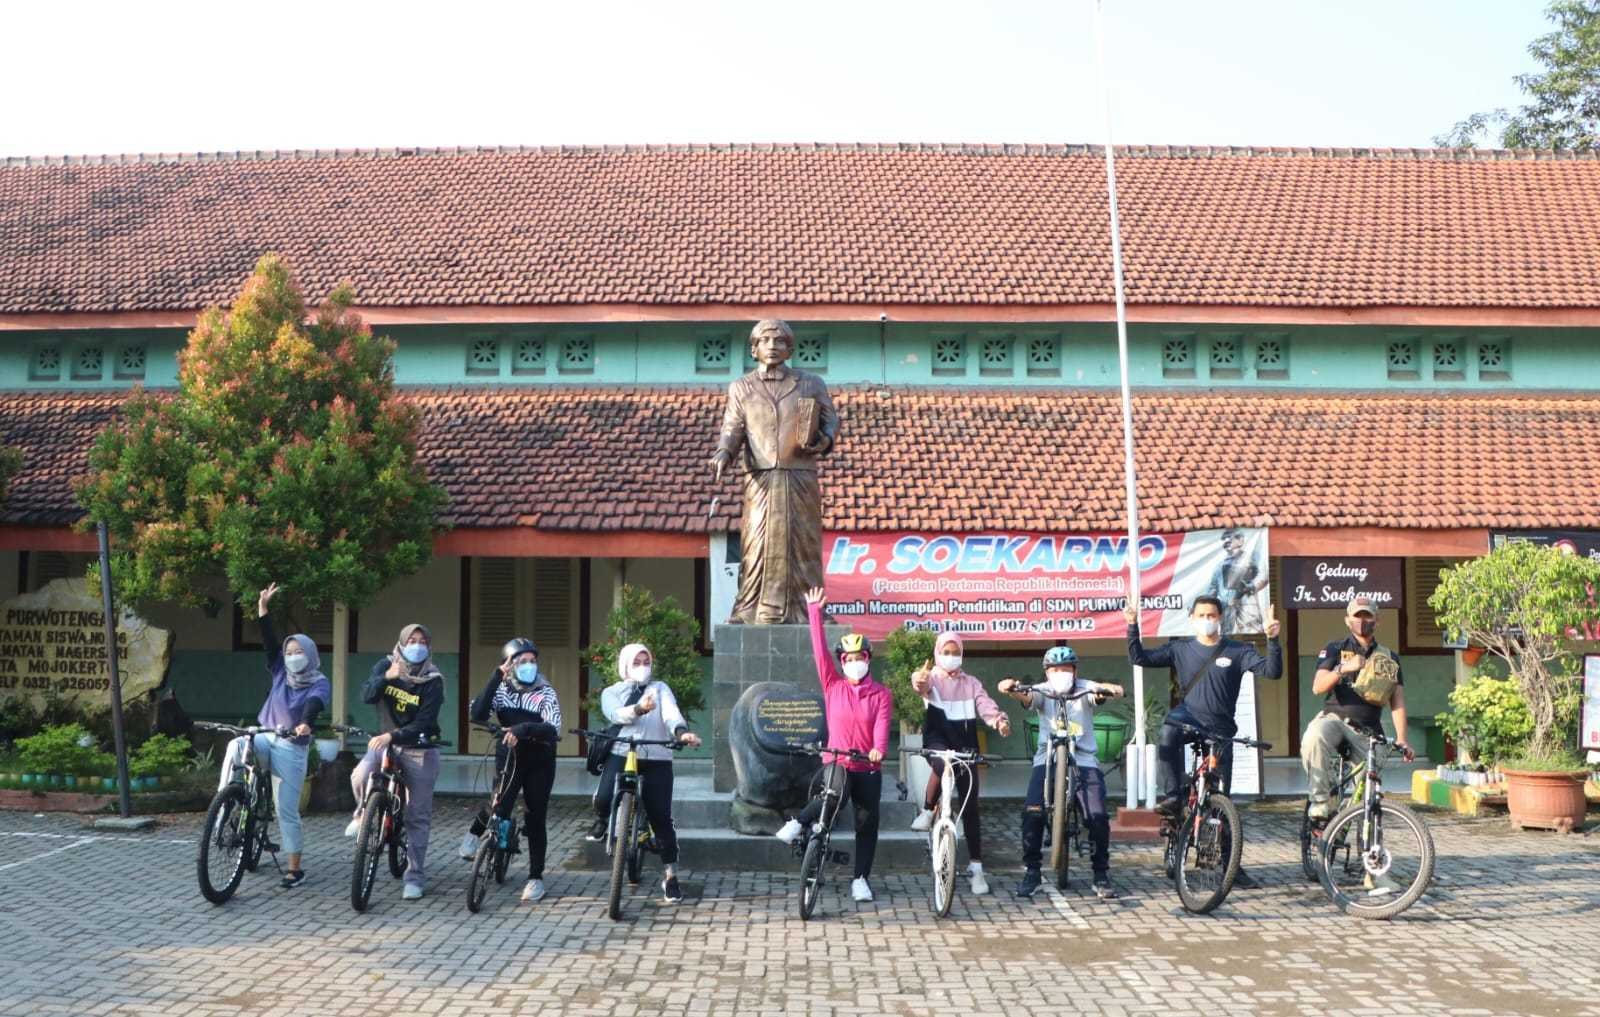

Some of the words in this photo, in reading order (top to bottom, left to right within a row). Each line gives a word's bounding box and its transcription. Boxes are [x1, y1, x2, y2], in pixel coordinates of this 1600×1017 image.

[826, 536, 876, 575] Ir.
[886, 534, 1167, 574] SOEKARNO
[1315, 562, 1368, 581] Gedung
[873, 577, 935, 595] (Presiden
[939, 577, 992, 592] Pertama
[995, 576, 1053, 594] Republik
[1056, 576, 1124, 592] Indonesia)
[1320, 585, 1392, 602] Soekarno
[825, 600, 865, 614] ernah
[869, 600, 944, 616] Menempuh
[948, 599, 1024, 613] Pendidikan
[1029, 599, 1042, 613] di
[1046, 598, 1075, 612] SDN
[1079, 595, 1183, 612] PURWOENGAH
[944, 619, 986, 632] Tahun
[991, 619, 1026, 632] 1907
[1030, 619, 1054, 633] s/d
[1059, 618, 1094, 631] 1912
[56, 646, 128, 659] MAGERSRI
